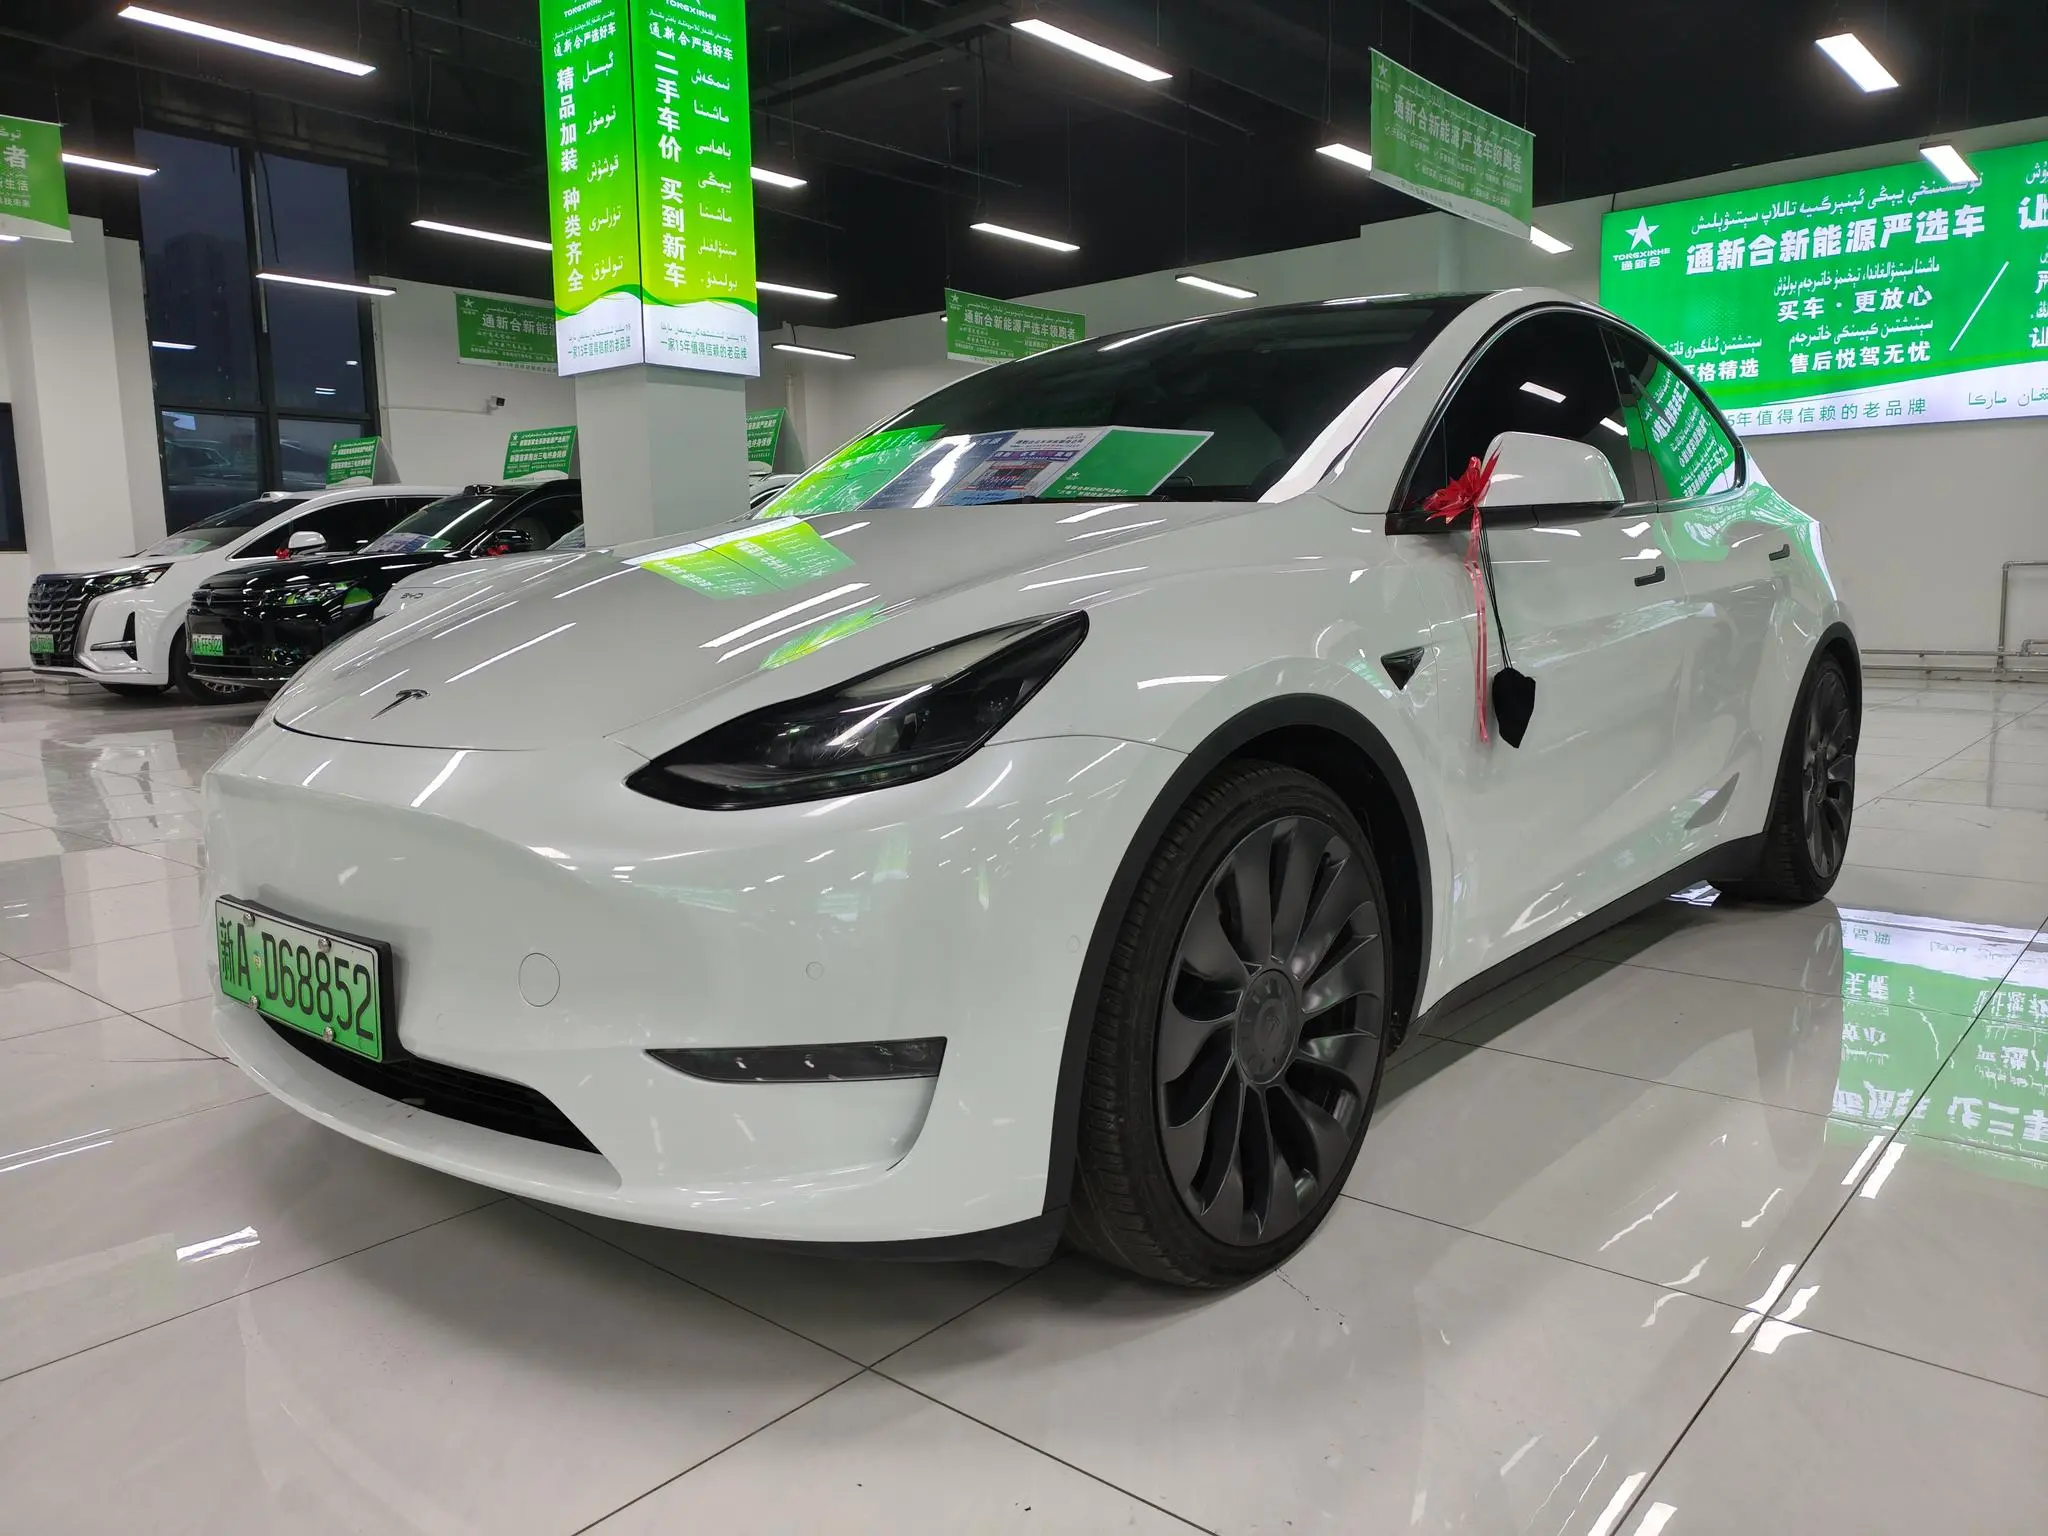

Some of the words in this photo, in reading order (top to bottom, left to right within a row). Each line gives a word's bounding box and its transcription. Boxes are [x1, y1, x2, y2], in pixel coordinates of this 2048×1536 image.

[553, 22, 616, 57] 通新合严选好车
[649, 22, 734, 61] 通新合严选好车
[556, 66, 578, 173] 精品加装
[654, 49, 682, 163] 二手车价
[563, 186, 584, 292] 种类齐全
[660, 176, 687, 288] 买到新车
[1686, 204, 1985, 275] 通新合新能源严选车
[1790, 340, 1932, 375] 售后悦驾无忧
